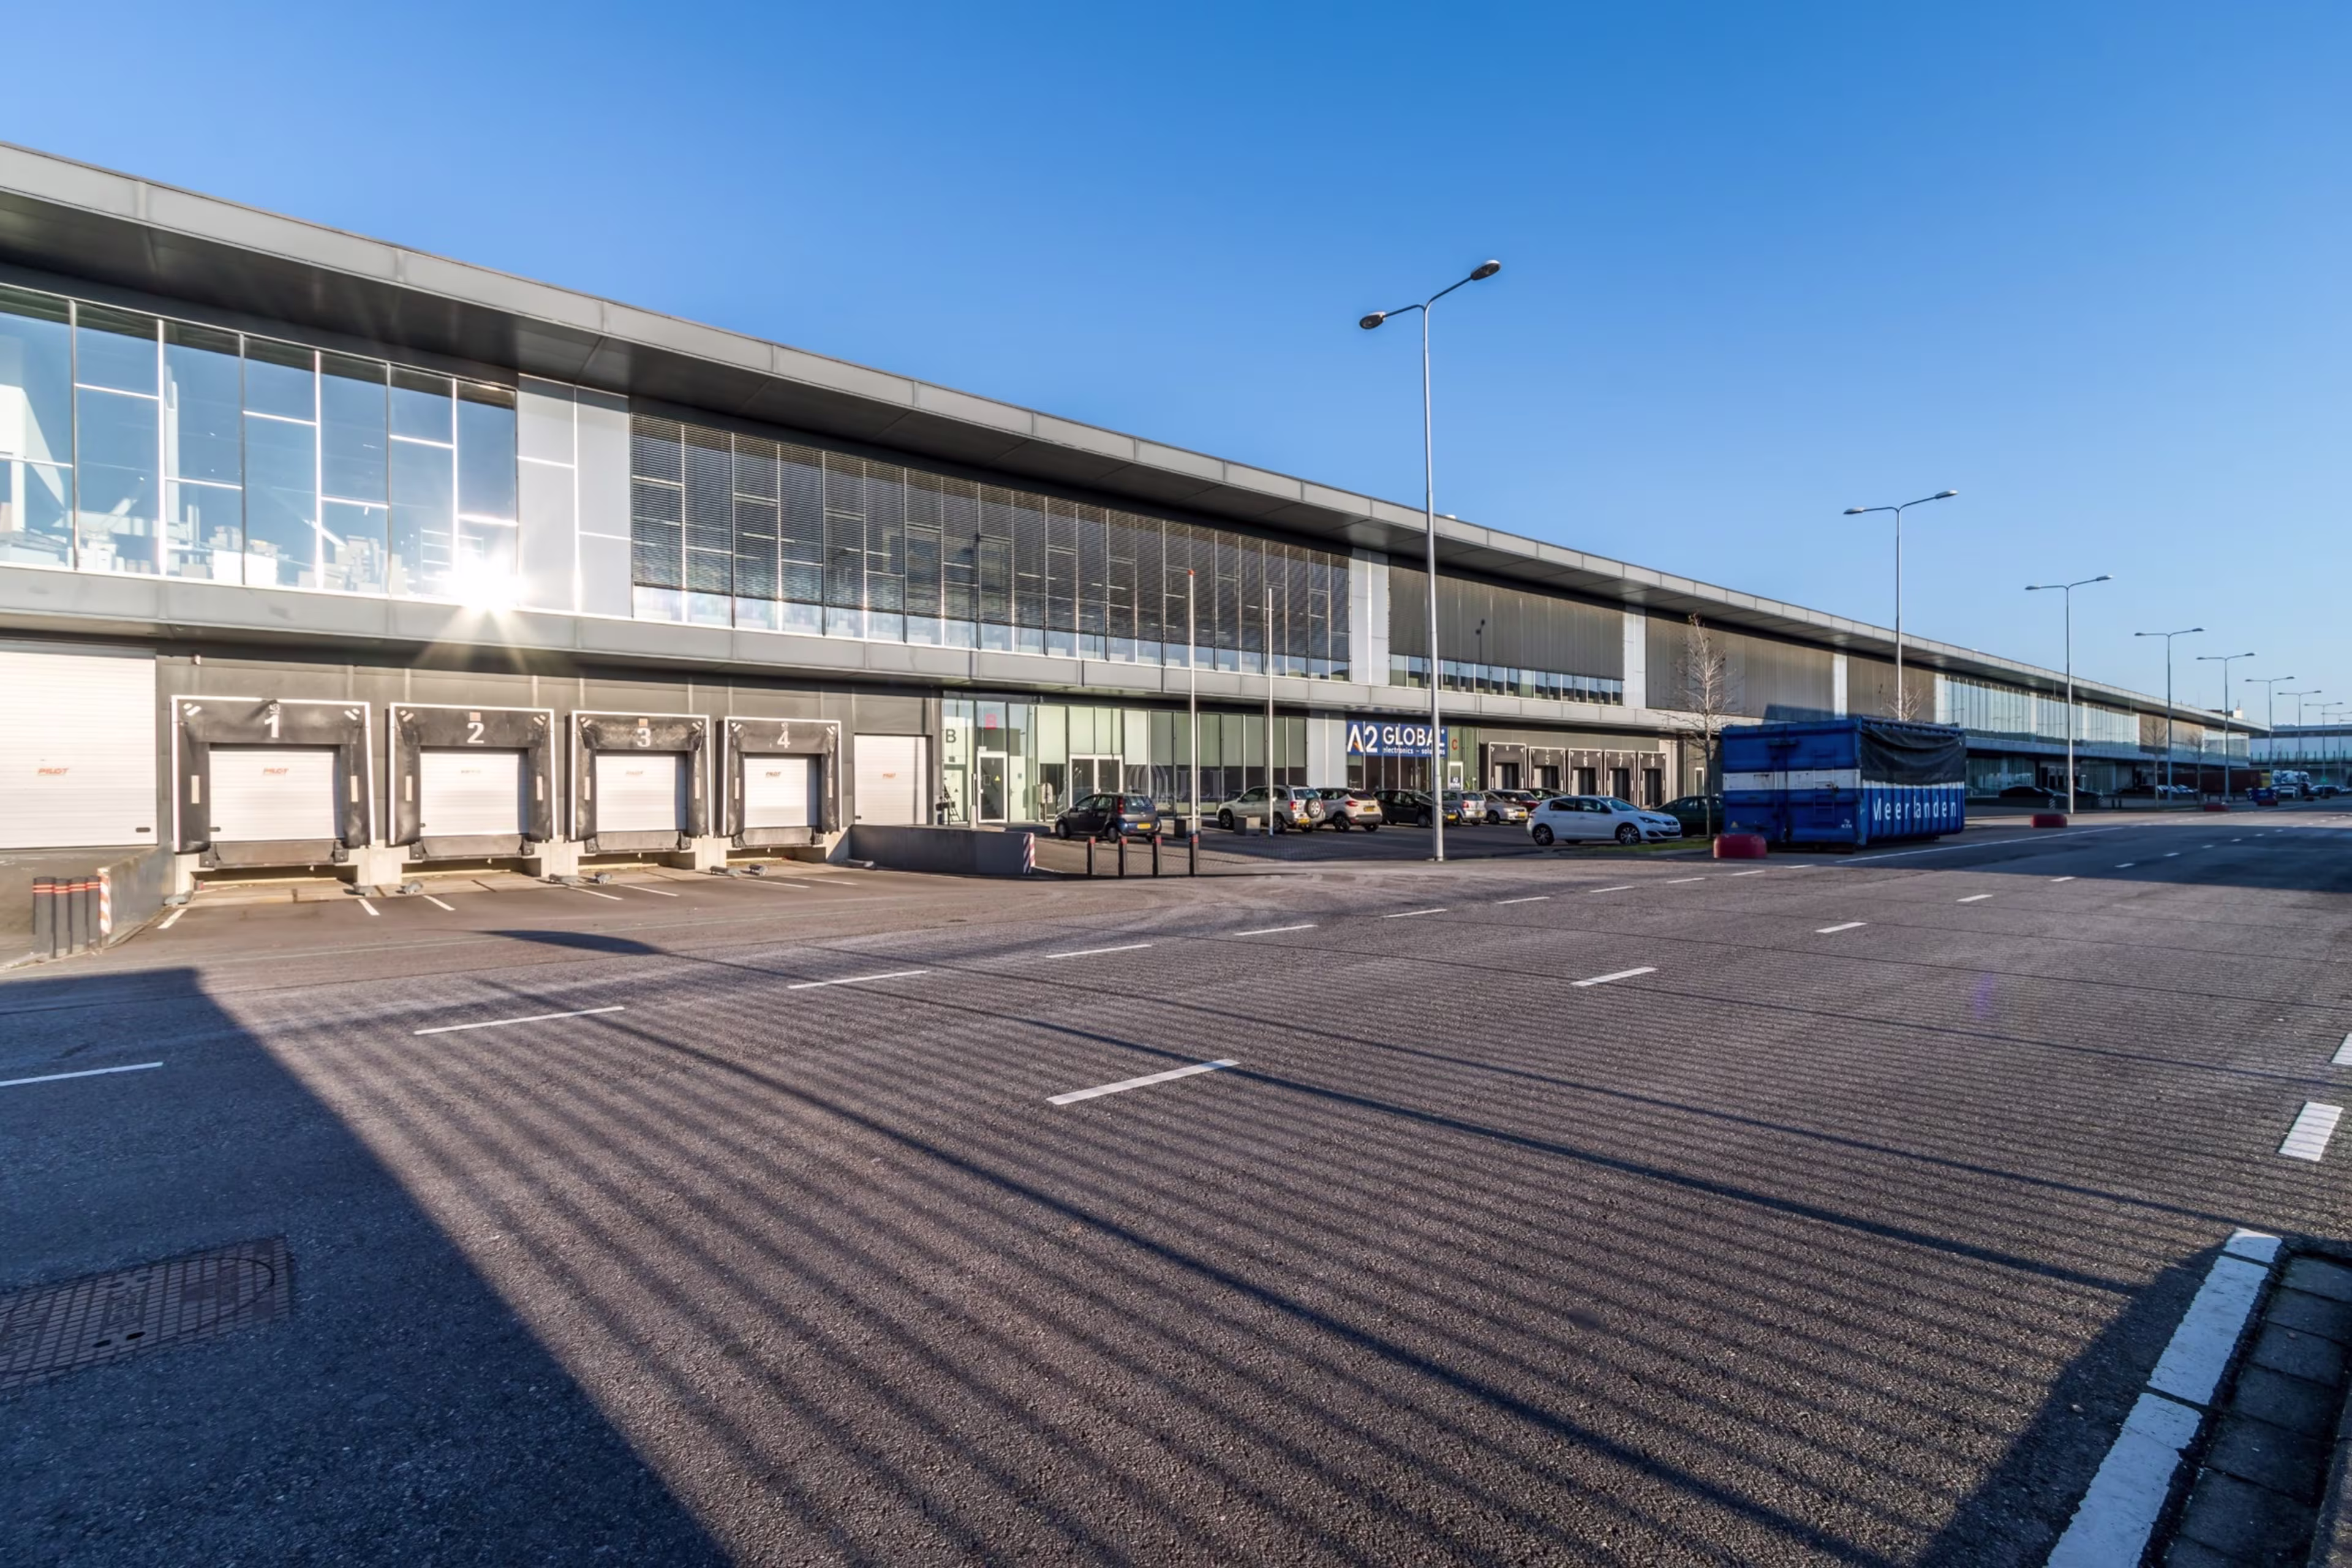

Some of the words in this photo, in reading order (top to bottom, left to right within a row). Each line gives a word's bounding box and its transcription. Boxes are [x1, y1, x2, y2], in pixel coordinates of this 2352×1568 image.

[265, 714, 279, 738] 1
[467, 722, 484, 744] 2
[945, 728, 957, 743] B
[637, 727, 650, 747] 3
[777, 730, 791, 748] 4
[1347, 724, 1378, 753] A2
[1382, 726, 1445, 747] GLOBAL
[1451, 739, 1458, 750] C
[1545, 755, 1551, 764] 5
